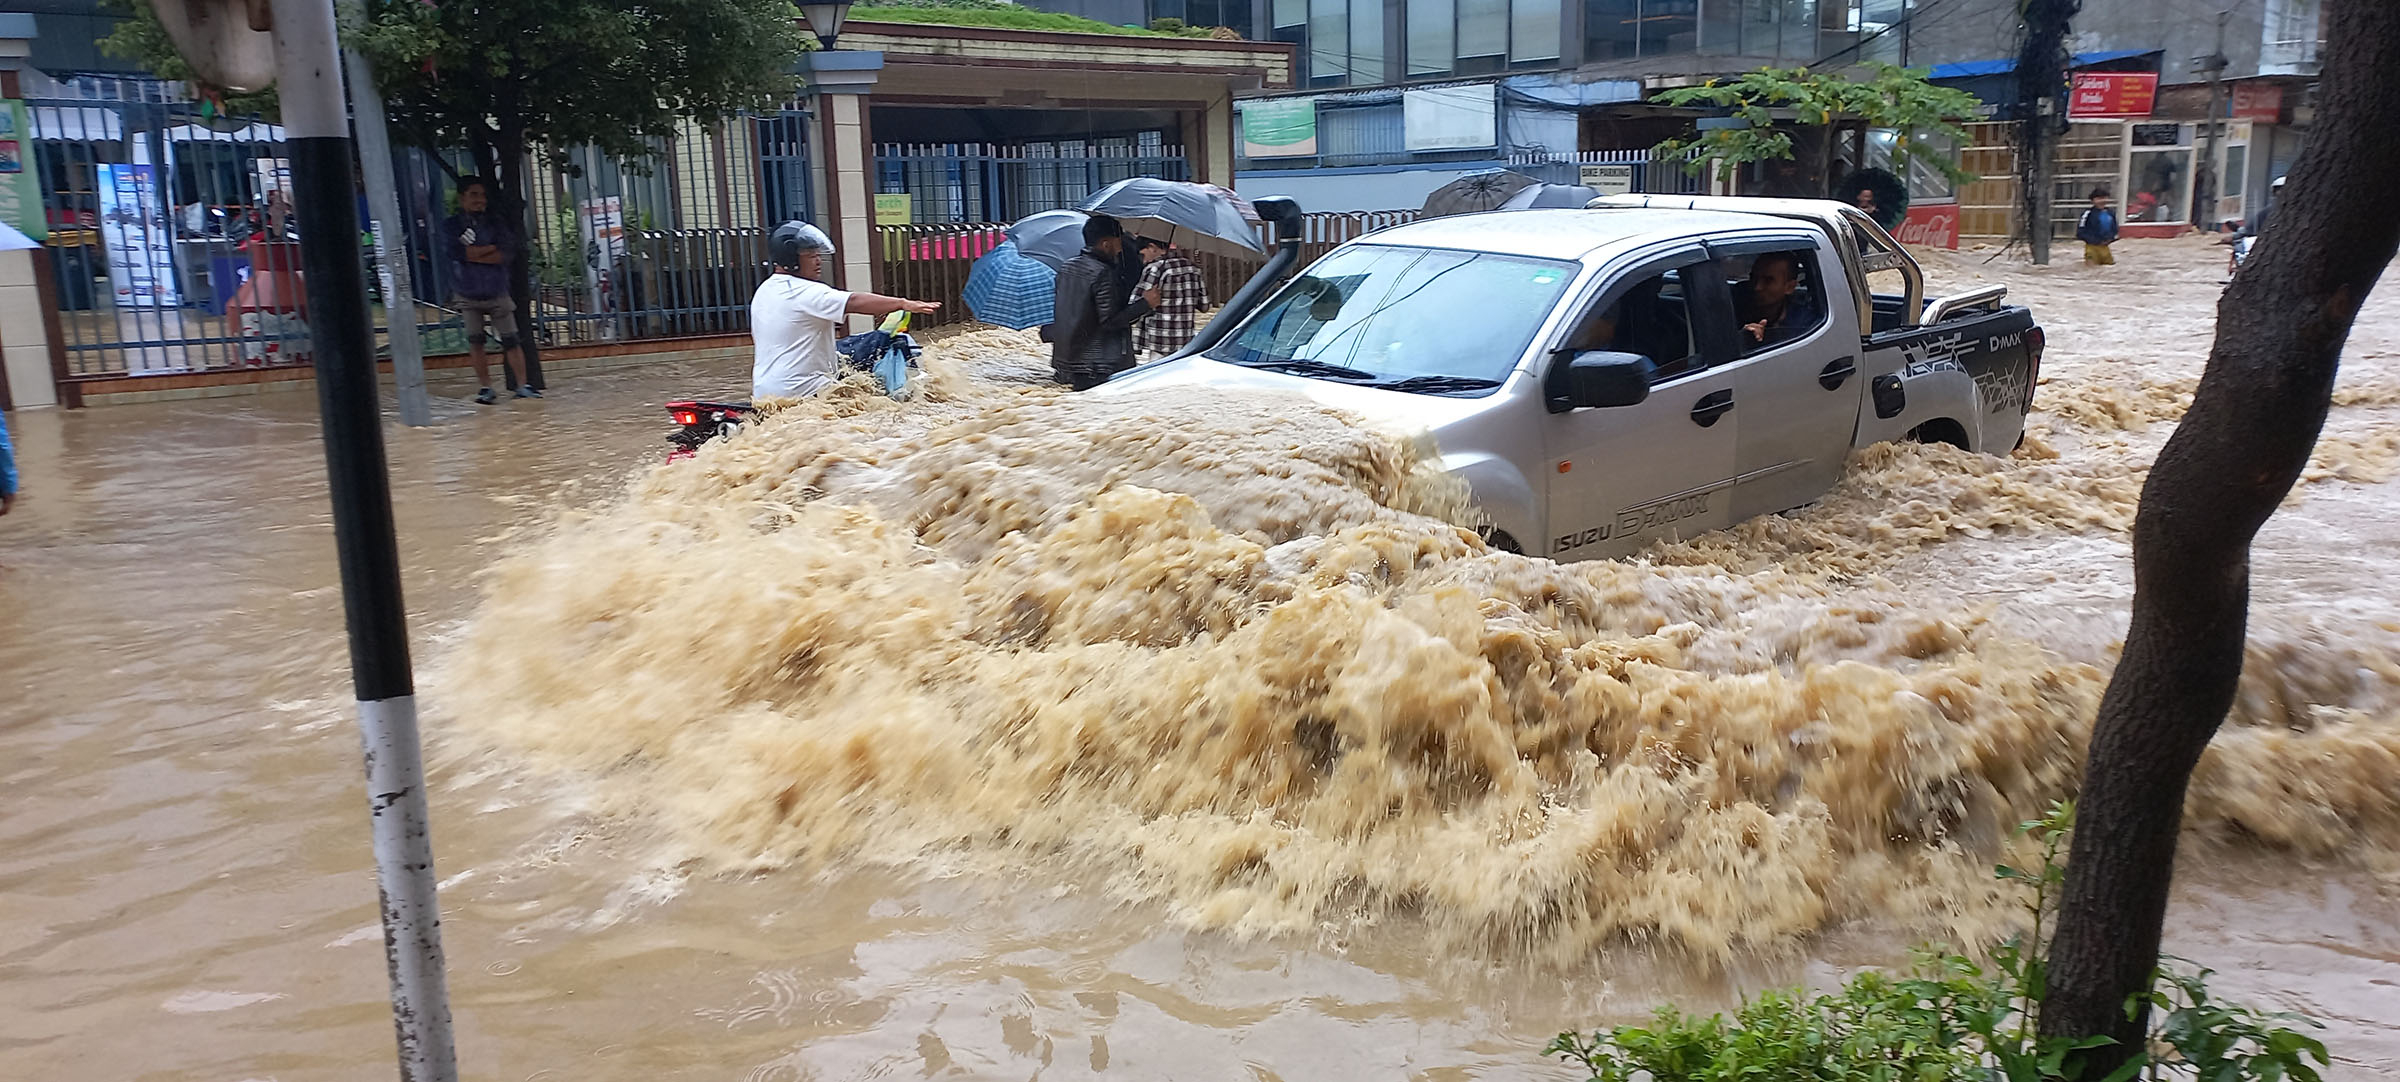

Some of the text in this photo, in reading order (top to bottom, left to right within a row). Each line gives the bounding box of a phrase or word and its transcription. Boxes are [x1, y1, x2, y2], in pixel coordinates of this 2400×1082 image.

[1581, 168, 1630, 177] BIKE PARKING
[1553, 493, 1712, 554] ISUZU D-MAX
